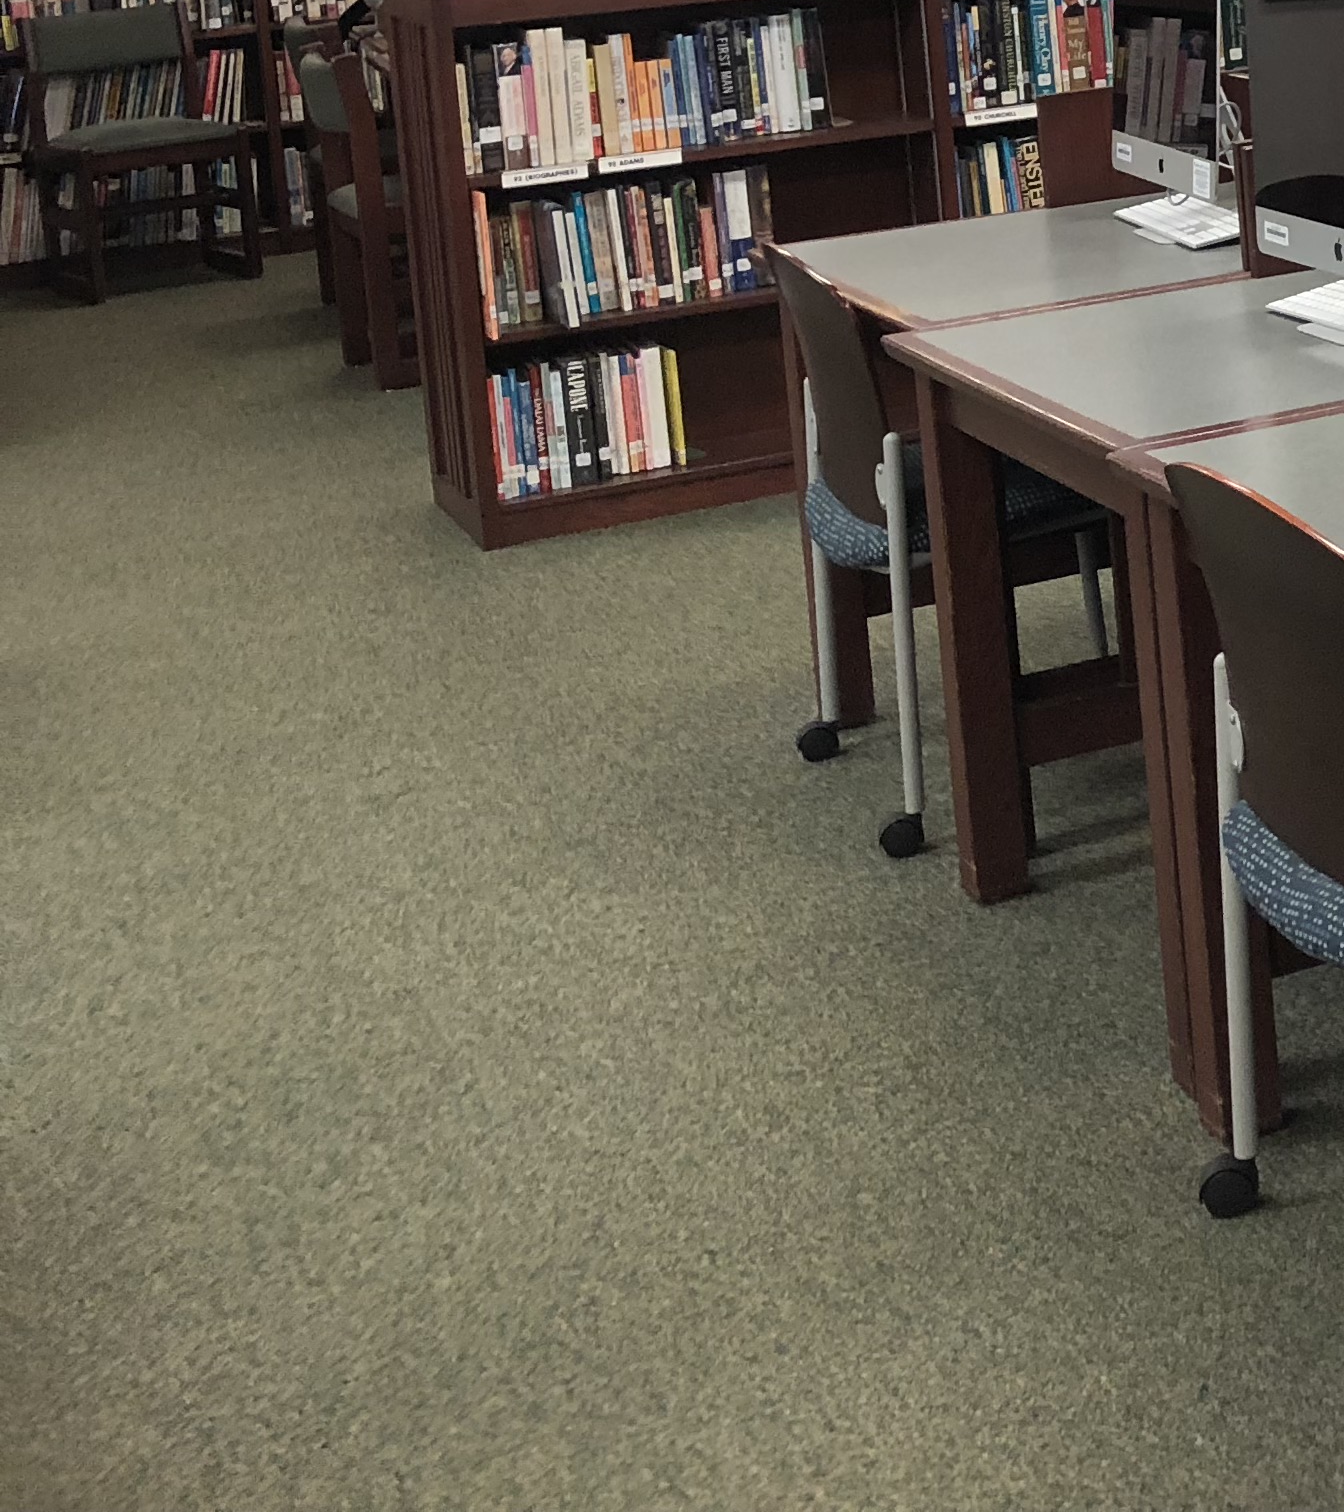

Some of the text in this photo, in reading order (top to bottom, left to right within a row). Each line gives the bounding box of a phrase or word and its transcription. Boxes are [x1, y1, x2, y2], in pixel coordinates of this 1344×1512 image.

[1036, 13, 1051, 73] Henry Clay
[1068, 39, 1084, 52] My
[716, 37, 734, 95] FIRST MAN
[571, 54, 586, 137] ABIGAIL ADAMS
[525, 168, 578, 182] (BIOGRAPHIES)
[619, 158, 645, 168] ADAMS
[536, 426, 547, 452] LAMA
